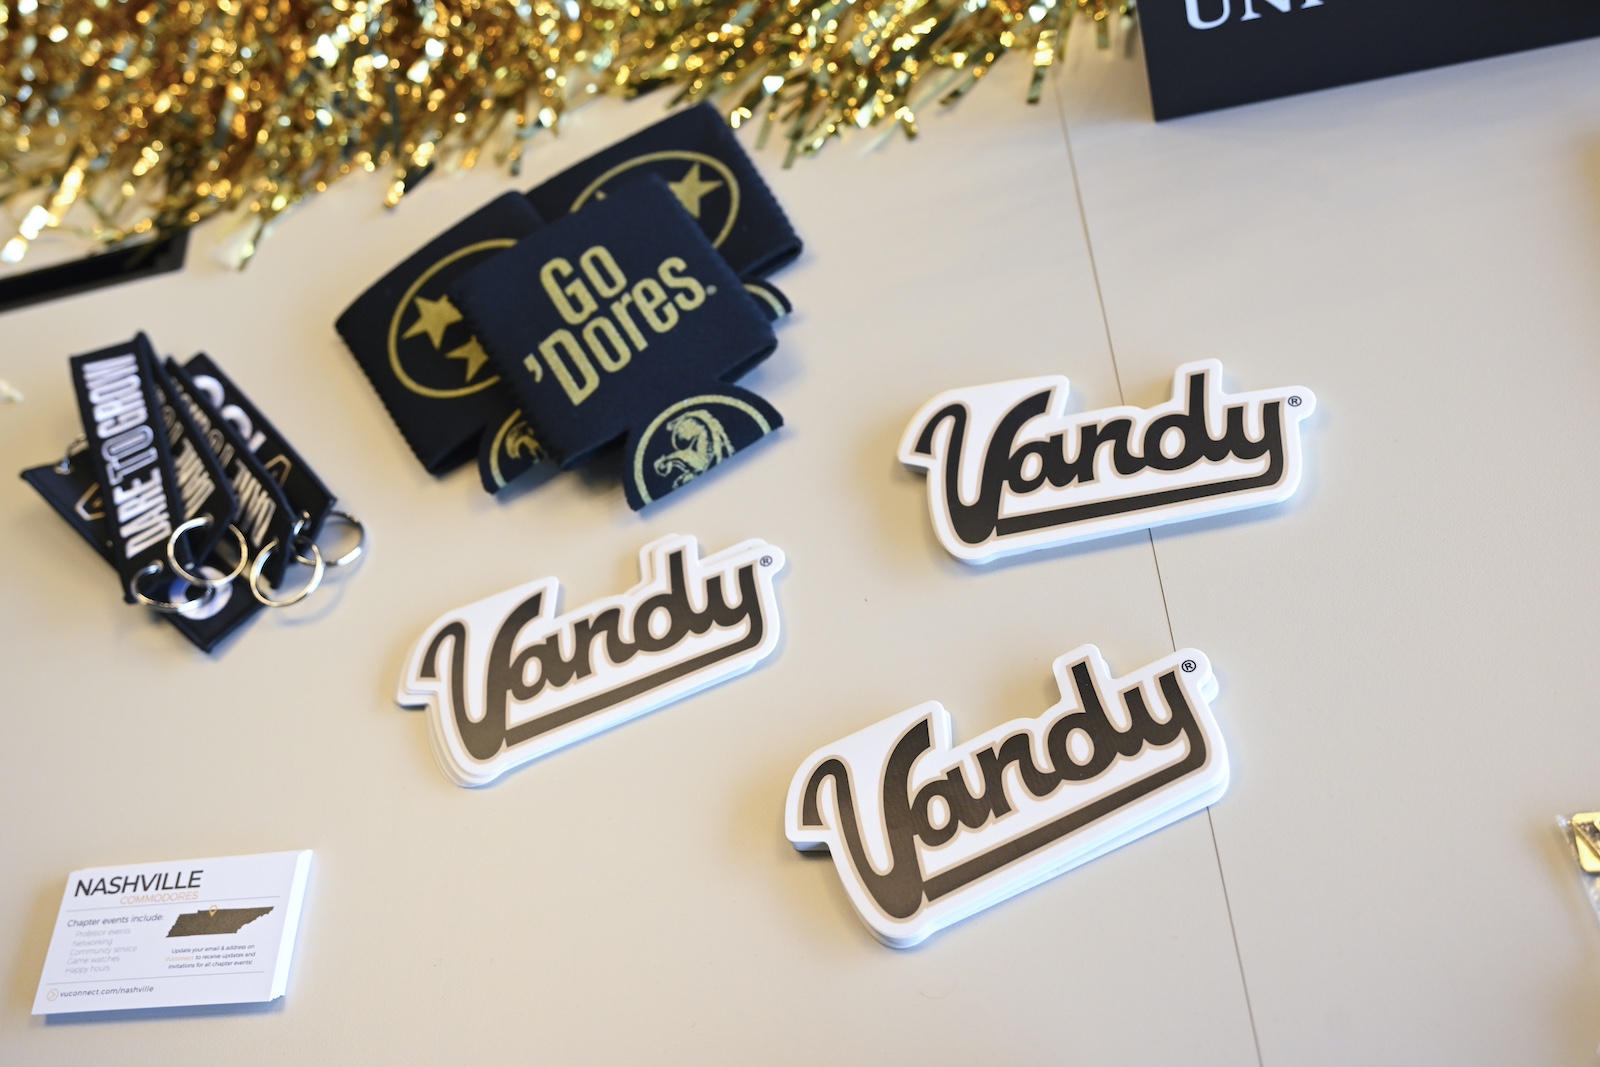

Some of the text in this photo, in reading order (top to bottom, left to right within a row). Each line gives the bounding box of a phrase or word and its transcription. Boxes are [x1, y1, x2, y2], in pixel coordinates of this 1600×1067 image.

[82, 353, 149, 439] GROW
[102, 424, 158, 486] TO
[112, 467, 173, 559] DARE
[74, 870, 204, 897] NASHVILLE
[120, 891, 199, 905] COMMODORES
[67, 913, 164, 928] Chapter events include:
[222, 952, 244, 960] updates
[168, 962, 195, 970] invitations
[212, 959, 233, 967] chapter
[60, 986, 154, 997] vuconnect.com/nashville
